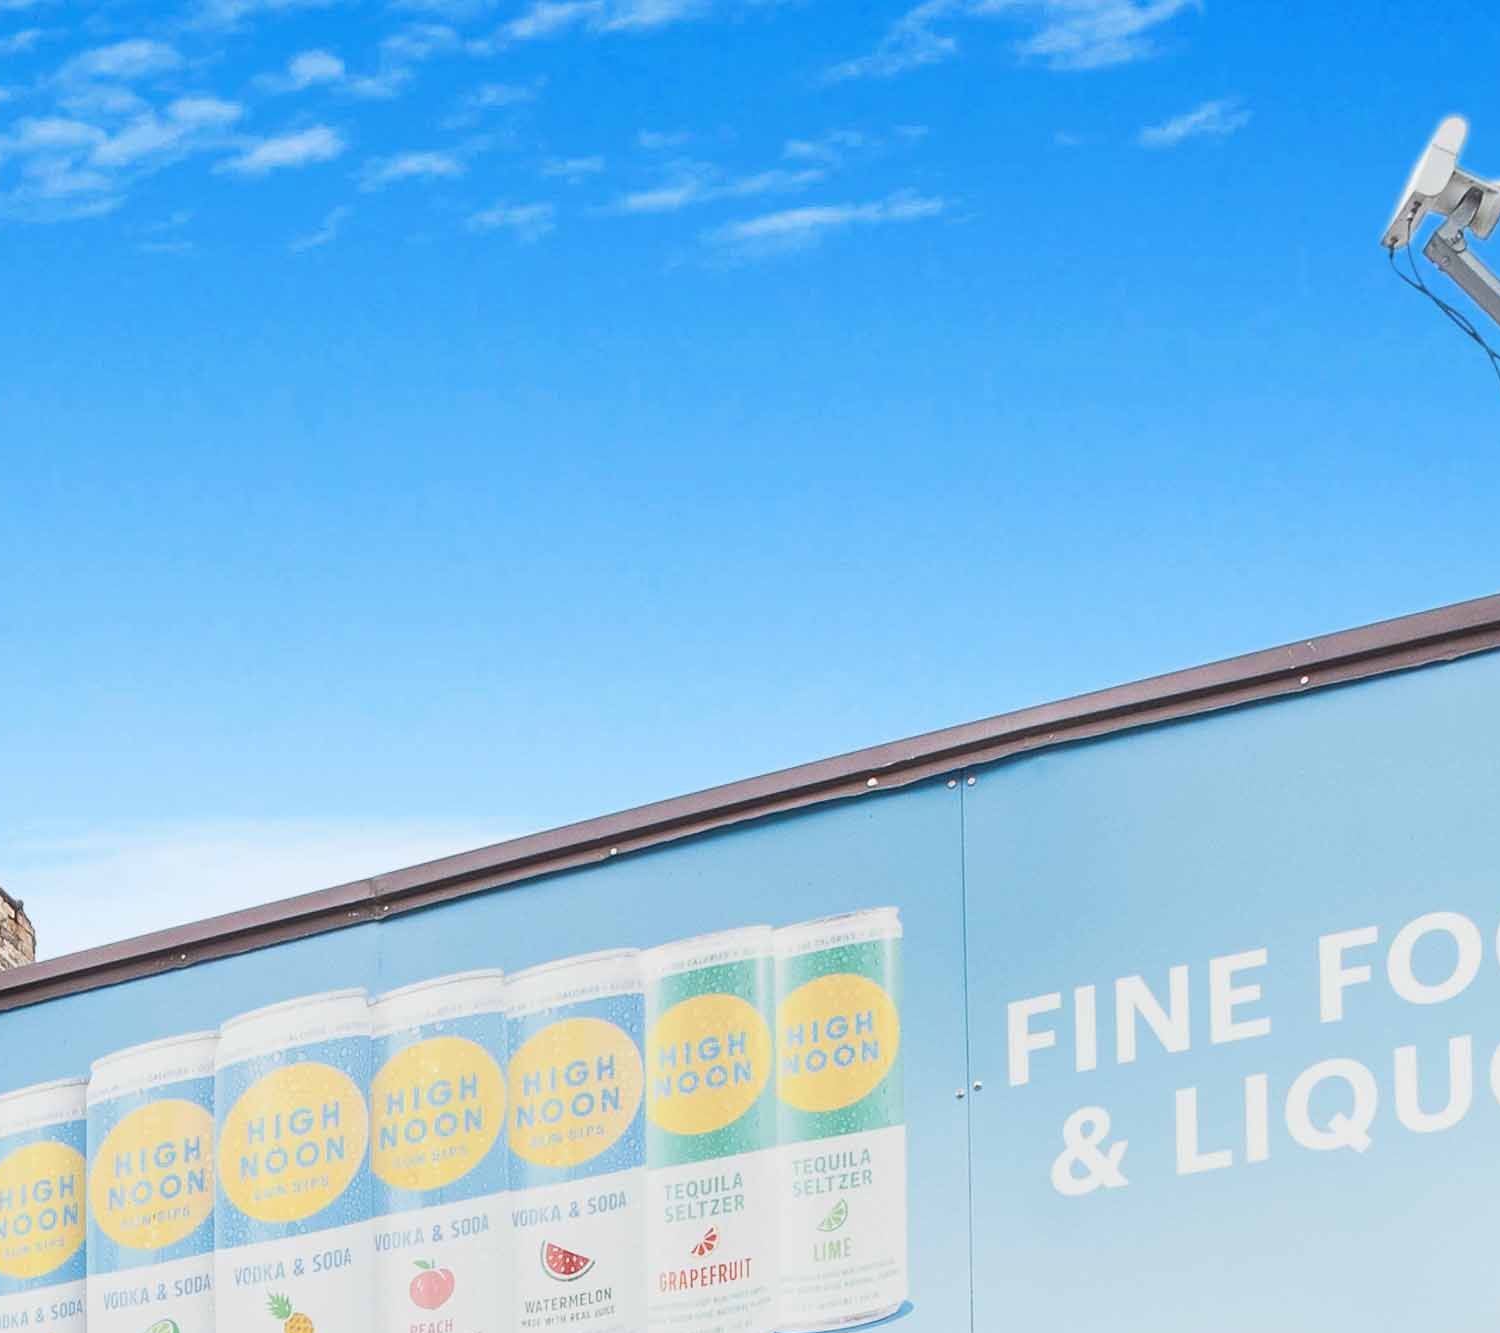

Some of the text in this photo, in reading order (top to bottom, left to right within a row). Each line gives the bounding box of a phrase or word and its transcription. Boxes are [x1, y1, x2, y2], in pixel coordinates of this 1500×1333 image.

[787, 1011, 873, 1047] HIGH
[1006, 948, 1272, 1086] FINE
[658, 1031, 746, 1069] HIGH
[783, 1040, 879, 1075] NOON
[522, 1055, 616, 1096] HIGH
[652, 1062, 752, 1098] NOON
[386, 1072, 479, 1116] HIGH
[515, 1086, 621, 1129] NOON
[379, 1105, 483, 1150] NOON
[793, 1149, 871, 1176] TEQUILA
[1049, 1105, 1130, 1197] &
[664, 1173, 743, 1201] TEQUILA
[793, 1169, 872, 1197] SELTZER
[512, 1190, 627, 1228] VODKA & SODA
[664, 1194, 745, 1223] SELTZER
[374, 1213, 489, 1252] VODKA & SODA
[813, 1237, 851, 1263] LIME
[659, 1257, 752, 1292] GRAPEFRUIT
[525, 1288, 612, 1314] WATERMELON
